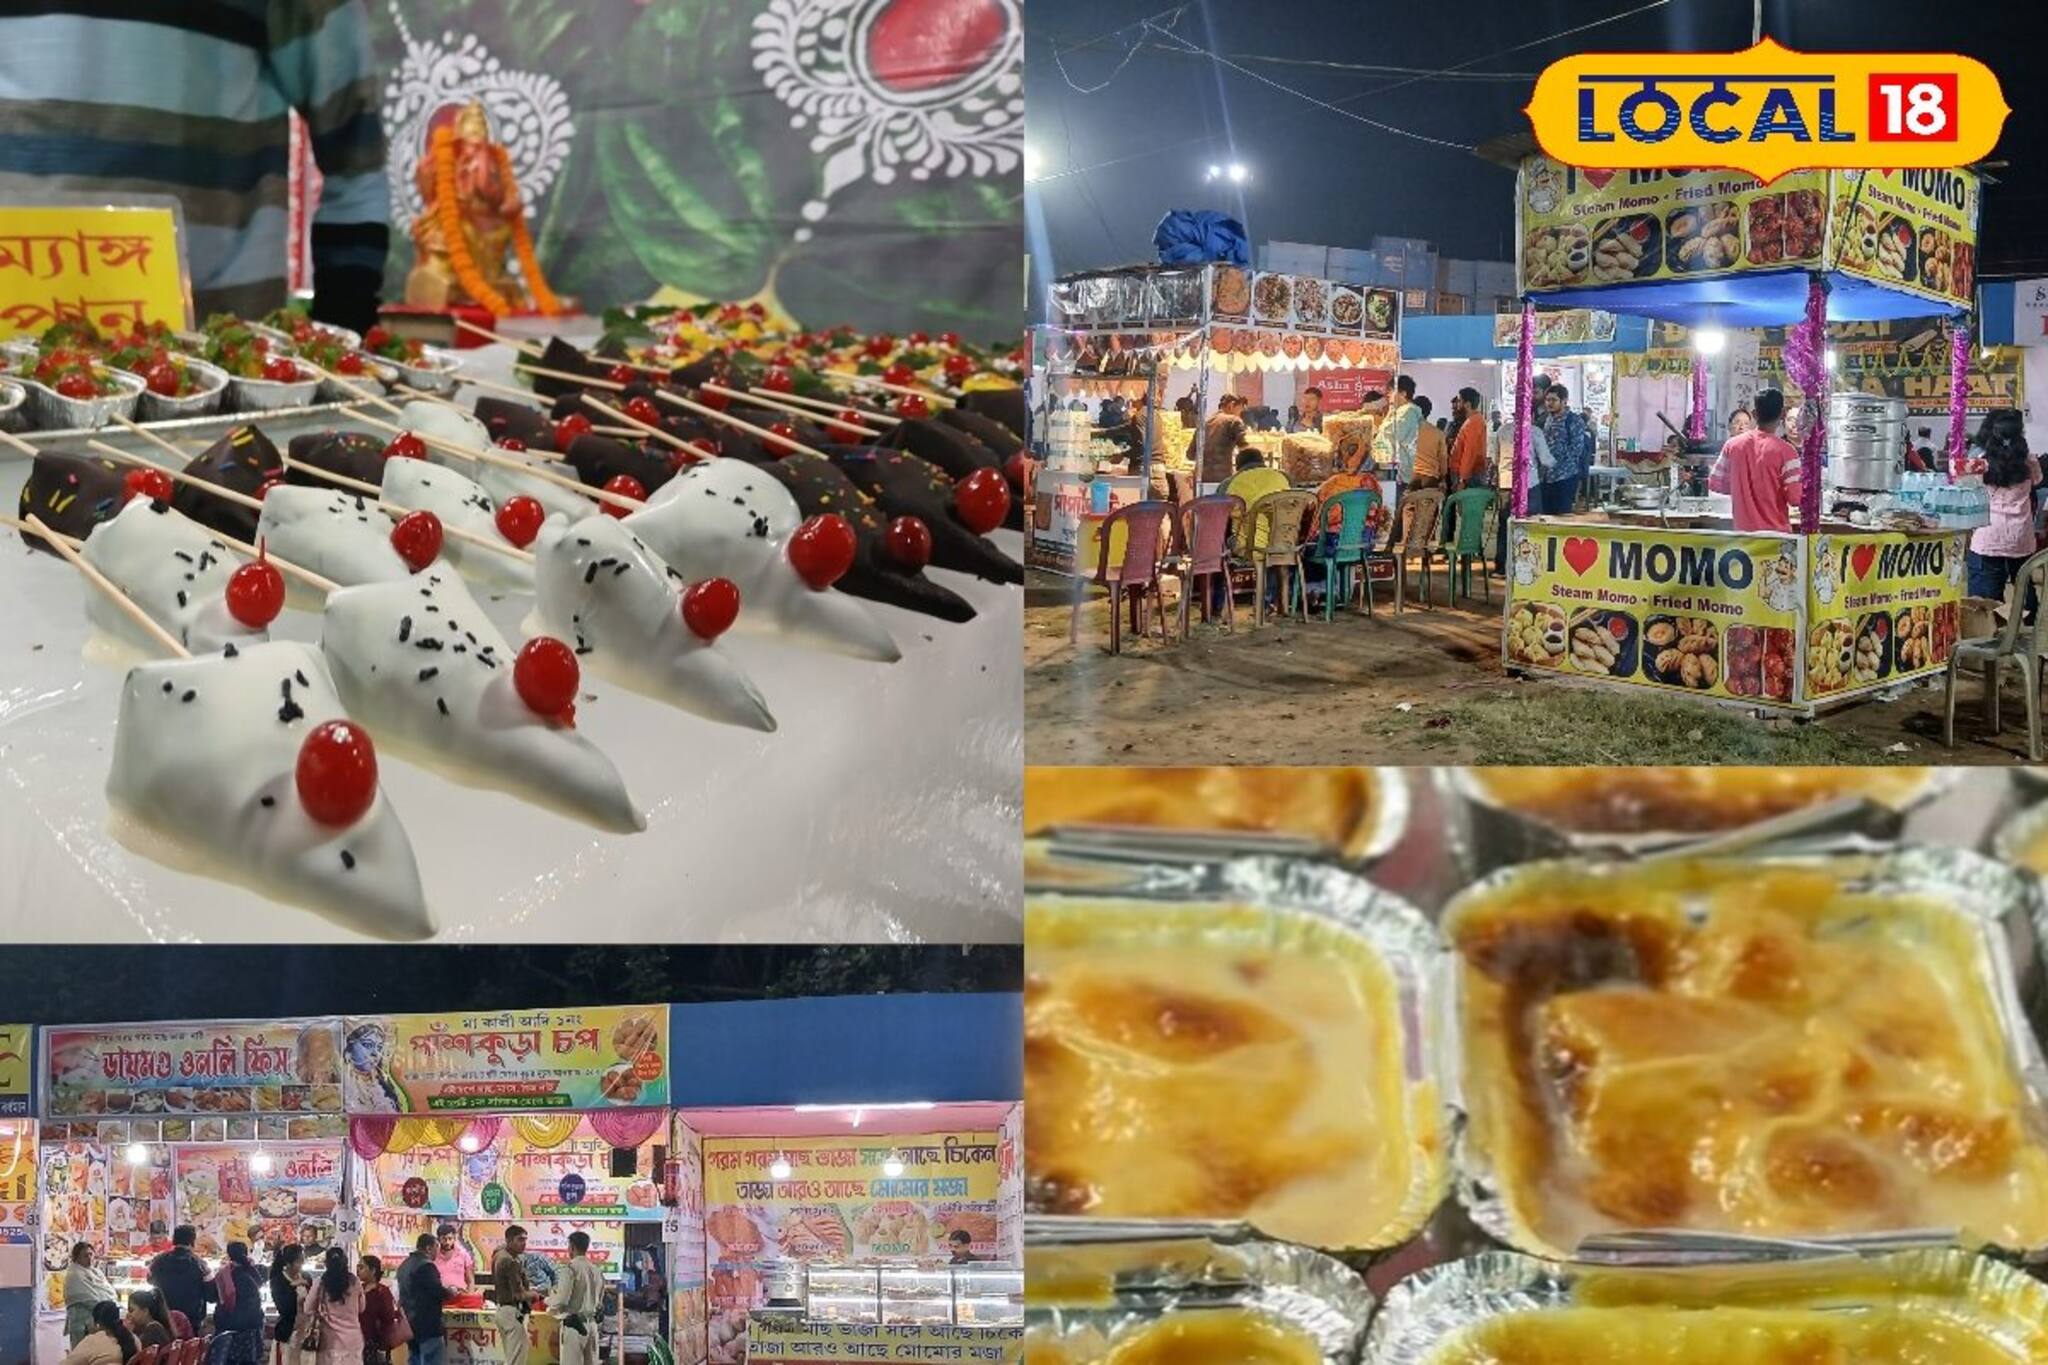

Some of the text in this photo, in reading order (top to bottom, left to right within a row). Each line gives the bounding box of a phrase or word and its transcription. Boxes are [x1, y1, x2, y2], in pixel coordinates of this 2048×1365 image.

[1572, 179, 1765, 217] Steam Momo Fried Momo
[1902, 168, 1966, 211] MOMO
[1546, 536, 1754, 590] I MOMO
[1877, 540, 1945, 580] MOMO
[1551, 584, 1744, 616] Steam Momo Fried Momo
[482, 1013, 515, 1029] কালী
[551, 1028, 601, 1055] চপ
[708, 1151, 741, 1171] গরম
[898, 1145, 941, 1166] আছে
[944, 1135, 997, 1165] চিকেন
[736, 1176, 969, 1201] তাজা আরও আছে মোমোর মজা
[339, 1221, 356, 1233] 34
[837, 1323, 878, 1337] ভাজা
[928, 1325, 974, 1339] আছে
[790, 1341, 838, 1357] আরও
[844, 1341, 889, 1357] আছে
[895, 1344, 962, 1358] মোমোর
[968, 1345, 1003, 1359] মজা
